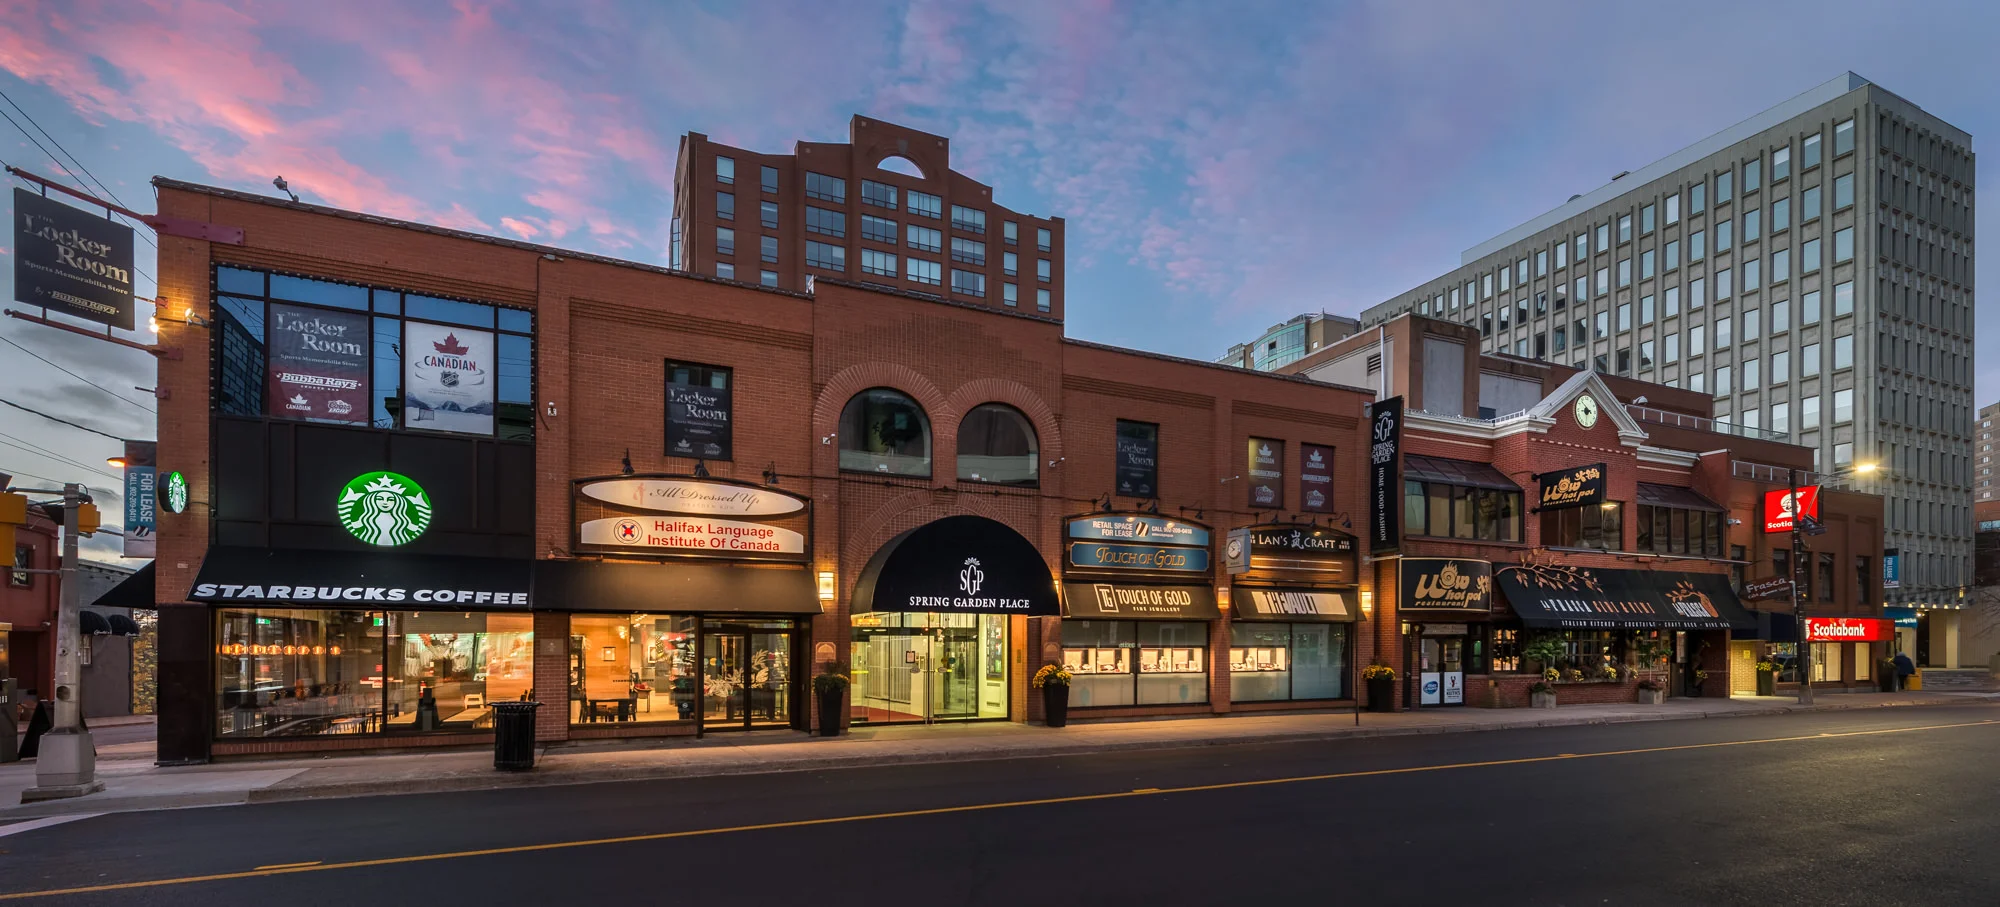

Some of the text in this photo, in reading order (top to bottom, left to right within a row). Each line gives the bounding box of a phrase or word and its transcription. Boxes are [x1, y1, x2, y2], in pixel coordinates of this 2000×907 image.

[24, 213, 112, 257] Locker
[56, 244, 129, 284] Room
[24, 260, 129, 295] Sports Memorabilia Store
[276, 313, 348, 337] Locker
[301, 333, 362, 356] Room
[302, 356, 341, 365] Memorabilia
[424, 355, 476, 371] CANADIAN
[281, 372, 358, 389] Bubba Ray's
[669, 388, 717, 407] Locker
[286, 403, 311, 411] CANADIAN
[686, 404, 727, 421] Room
[1374, 416, 1394, 442] SGP
[1371, 446, 1395, 458] GARDEN
[1372, 440, 1394, 450] SPRING
[1128, 453, 1154, 467] Room
[1373, 454, 1391, 464] PLACE
[129, 472, 137, 486] CALL
[141, 473, 153, 522] FOR LEASE
[650, 487, 760, 511] All Dressed Up
[654, 520, 774, 539] Halifax Language
[1093, 521, 1133, 530] RETAIL SPACE
[1102, 528, 1133, 538] FOR LEASE
[1379, 512, 1387, 541] FASHION
[648, 534, 780, 551] Institute Of Canada
[1259, 534, 1288, 546] LAN'S
[1304, 537, 1335, 549] CRAFT
[1096, 547, 1137, 563] TOUCH
[1154, 549, 1187, 568] GOLD
[960, 564, 984, 596] SGP
[1745, 577, 1787, 593] Frasca
[193, 584, 528, 605] STARBUCKS COFFEE
[909, 596, 1030, 608] SPRING GARDEN PLACE
[1115, 589, 1191, 606] TOUCH OF GOLD
[1813, 622, 1865, 637] Scotiabank
